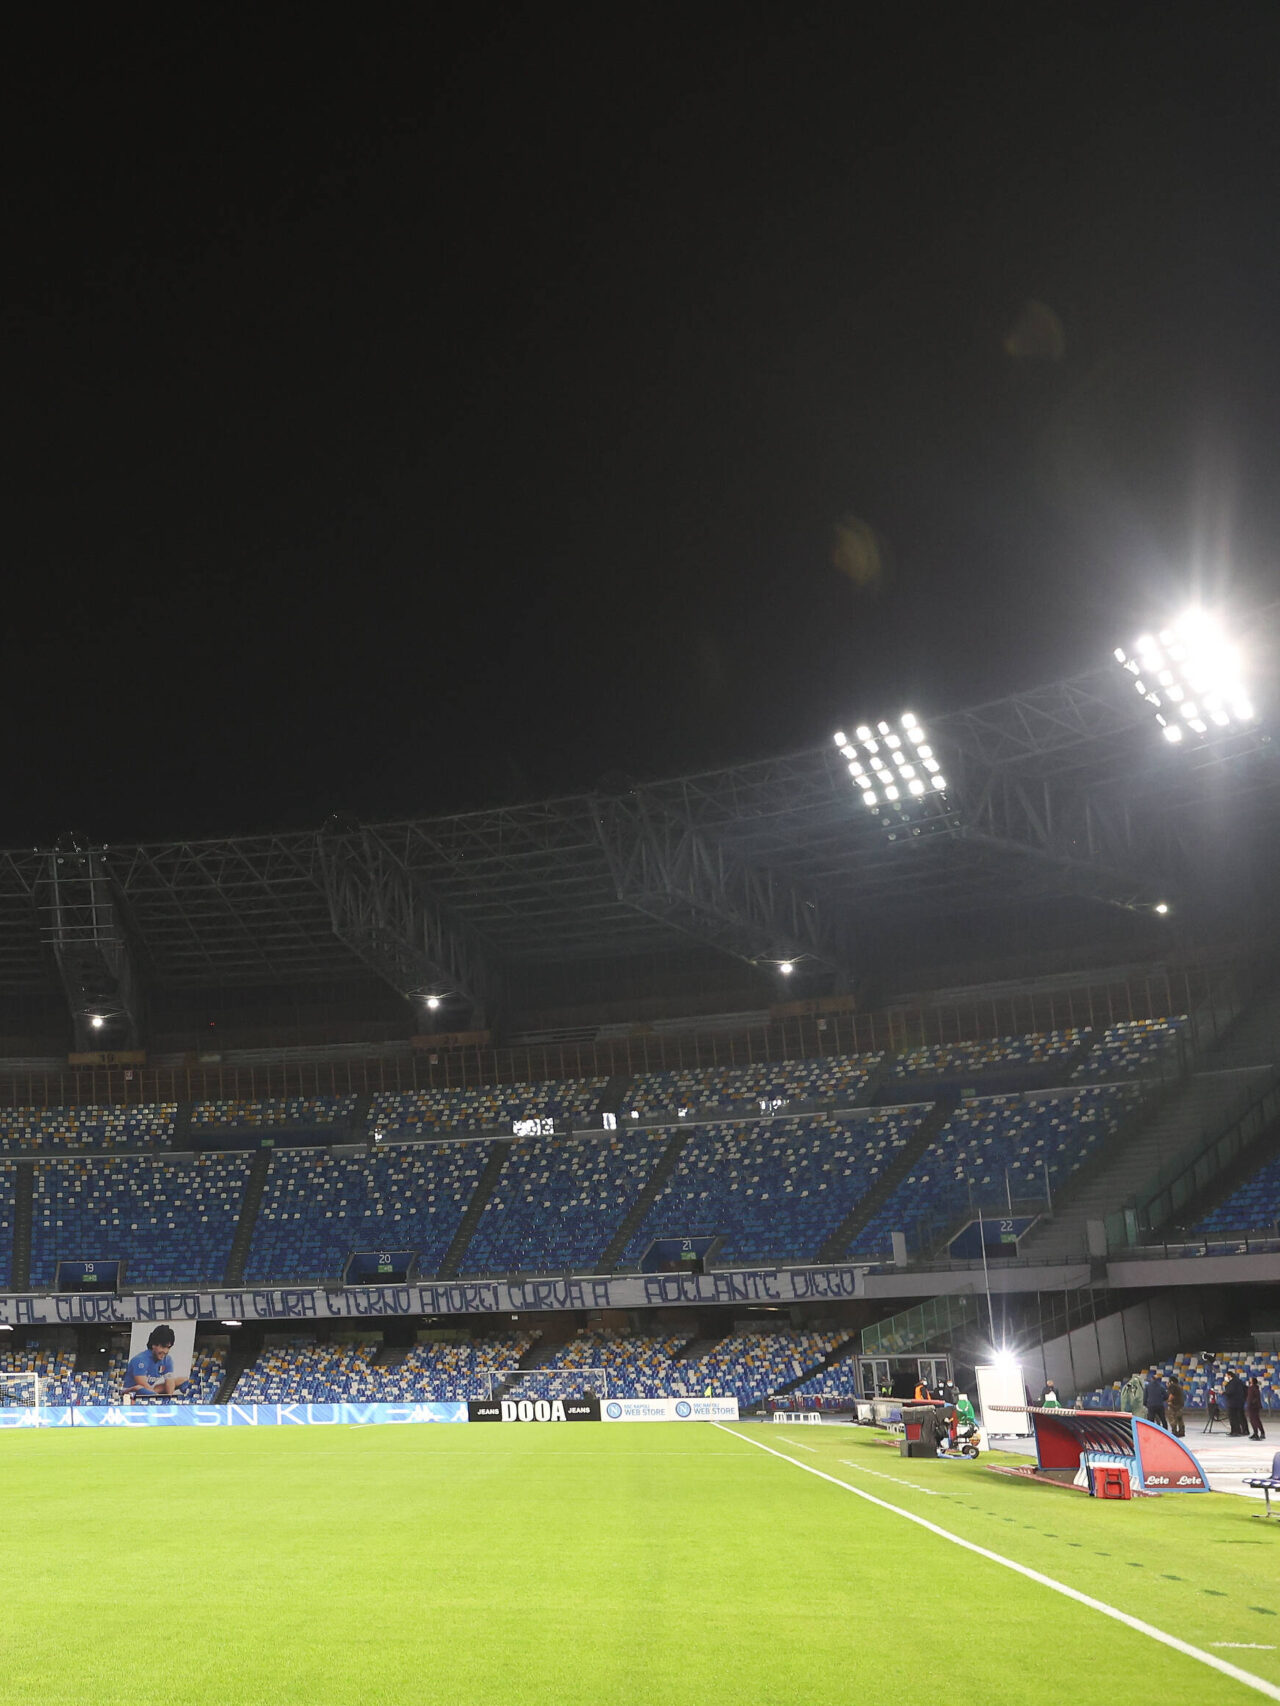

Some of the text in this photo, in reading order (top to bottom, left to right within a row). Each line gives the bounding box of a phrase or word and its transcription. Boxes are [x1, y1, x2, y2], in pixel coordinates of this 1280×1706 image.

[1000, 1220, 1013, 1232] 22
[682, 1240, 692, 1250] 21
[378, 1254, 391, 1264] 20
[84, 1263, 94, 1273] 19
[16, 1299, 47, 1324] AL
[136, 1294, 218, 1320] NAPOLI
[225, 1293, 245, 1318] TI
[253, 1291, 317, 1317] GIURA
[325, 1288, 411, 1317] ETERNO
[508, 1281, 586, 1309] CURVA
[592, 1281, 611, 1306] A
[644, 1271, 781, 1304] ADELANTE
[790, 1268, 856, 1298] DIEGO
[500, 1400, 567, 1422] DOOA
[624, 1408, 666, 1416] WEB STORE
[694, 1407, 735, 1415] WEB STORE
[1144, 1475, 1170, 1486] Lete
[1176, 1475, 1202, 1486] Lete
